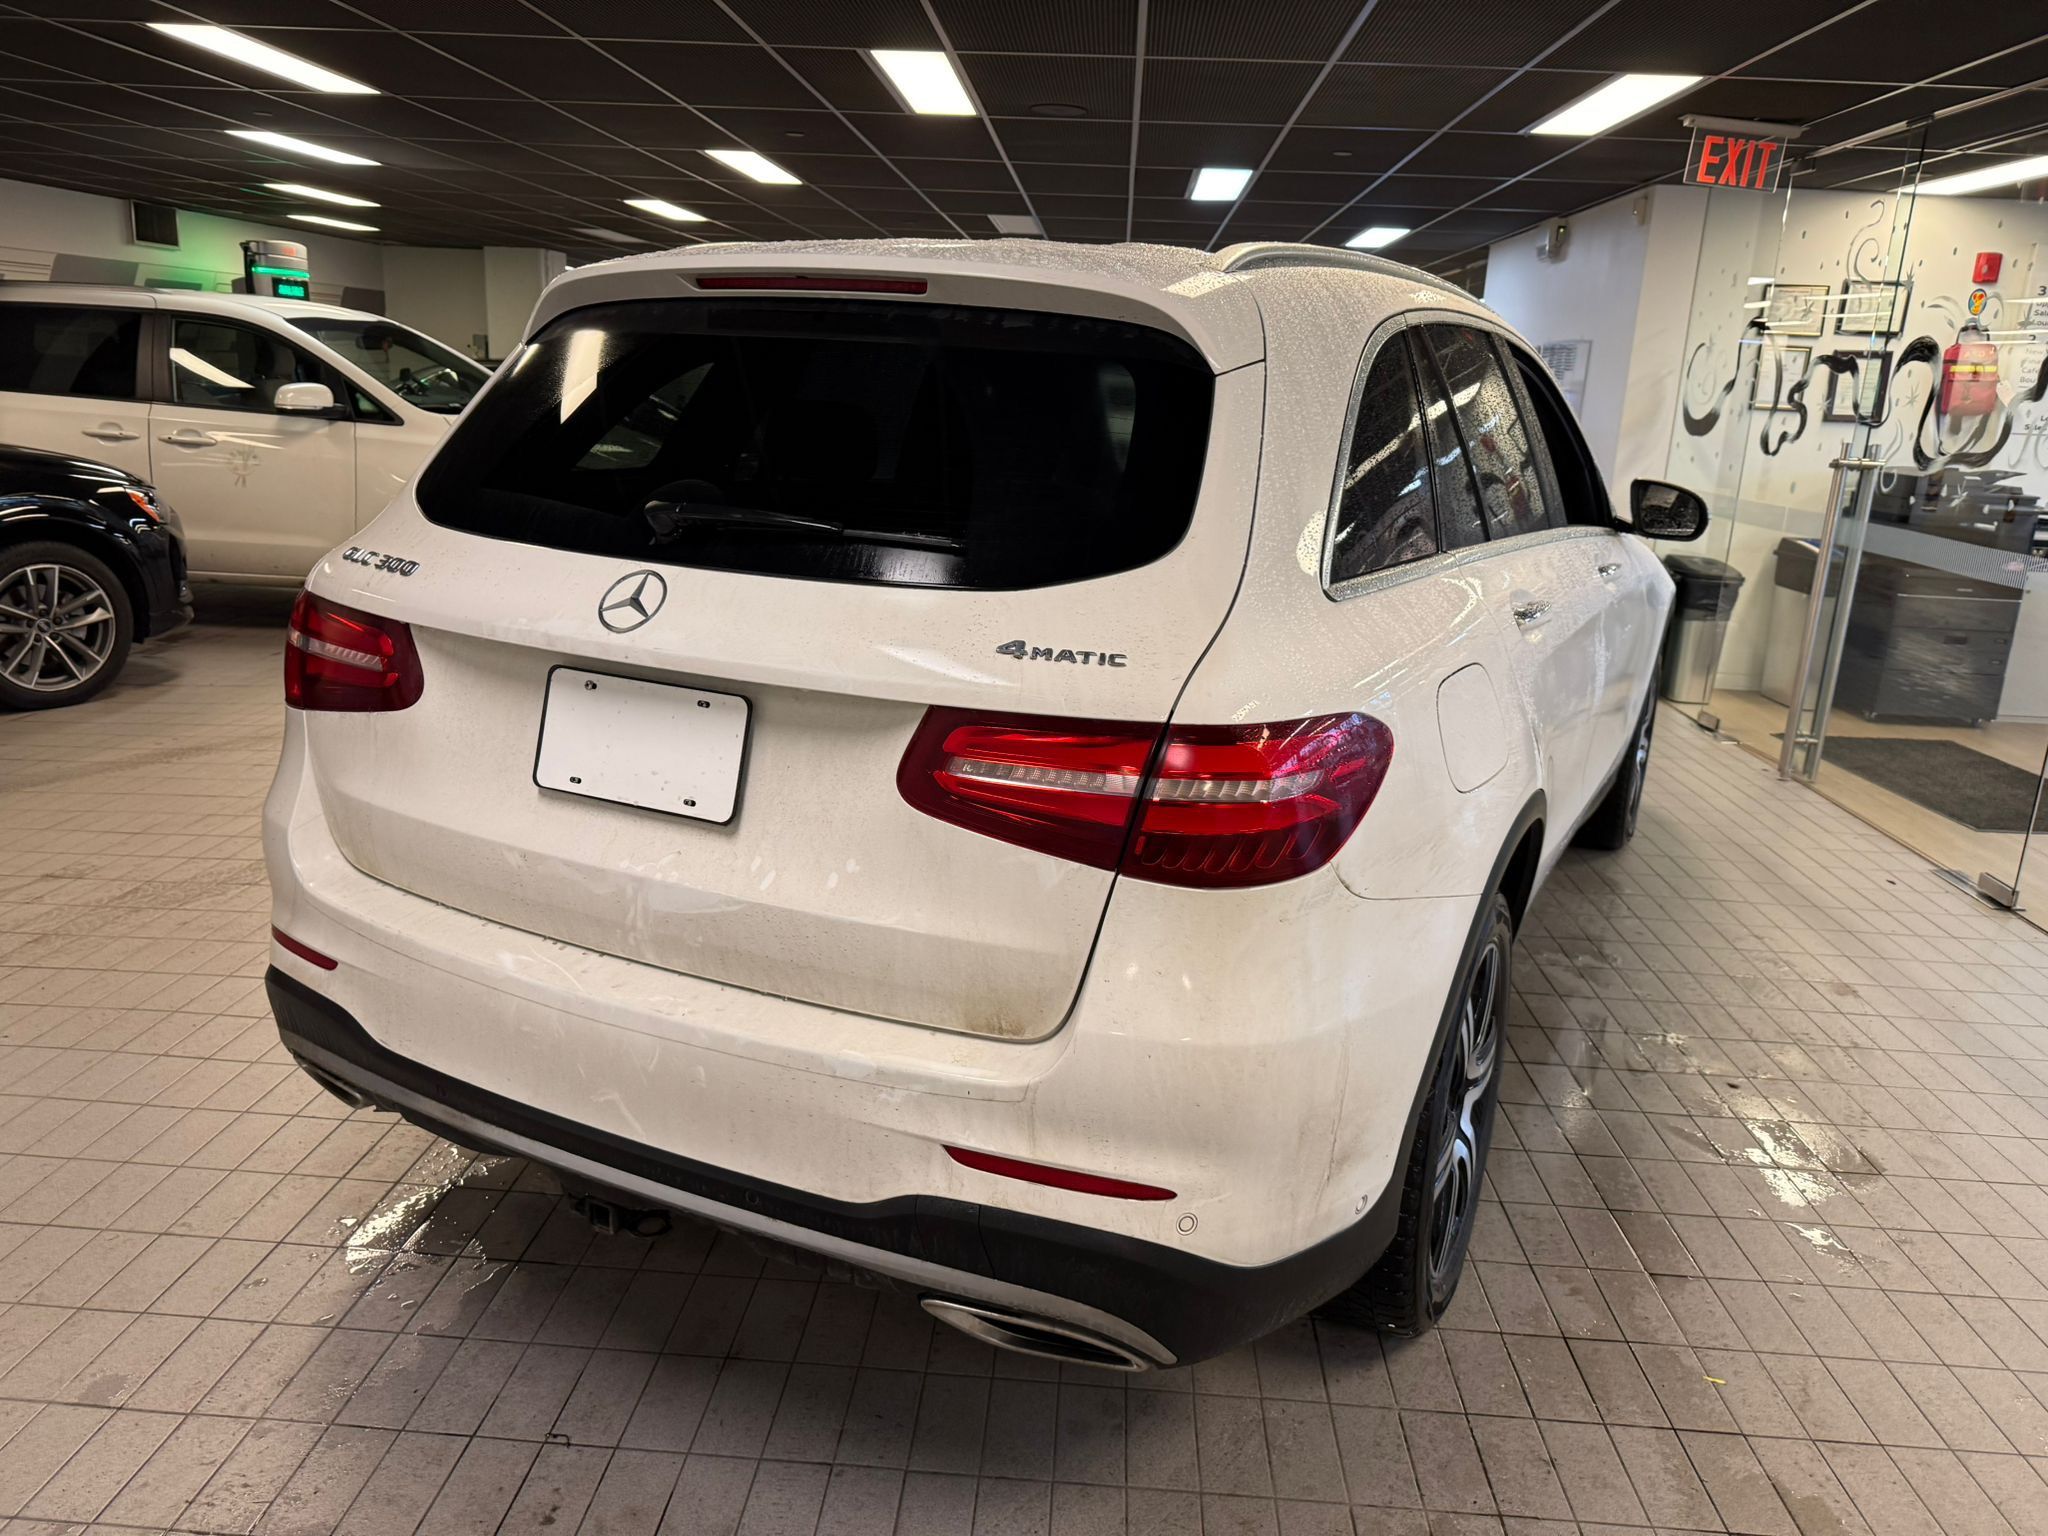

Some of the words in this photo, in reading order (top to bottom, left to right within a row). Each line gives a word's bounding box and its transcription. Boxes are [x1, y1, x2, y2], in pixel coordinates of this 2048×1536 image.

[1696, 135, 1777, 189] EXIT
[2038, 285, 2048, 296] 3
[343, 546, 380, 567] GLC
[374, 554, 420, 577] 300
[996, 640, 1129, 667] 4MATIC
